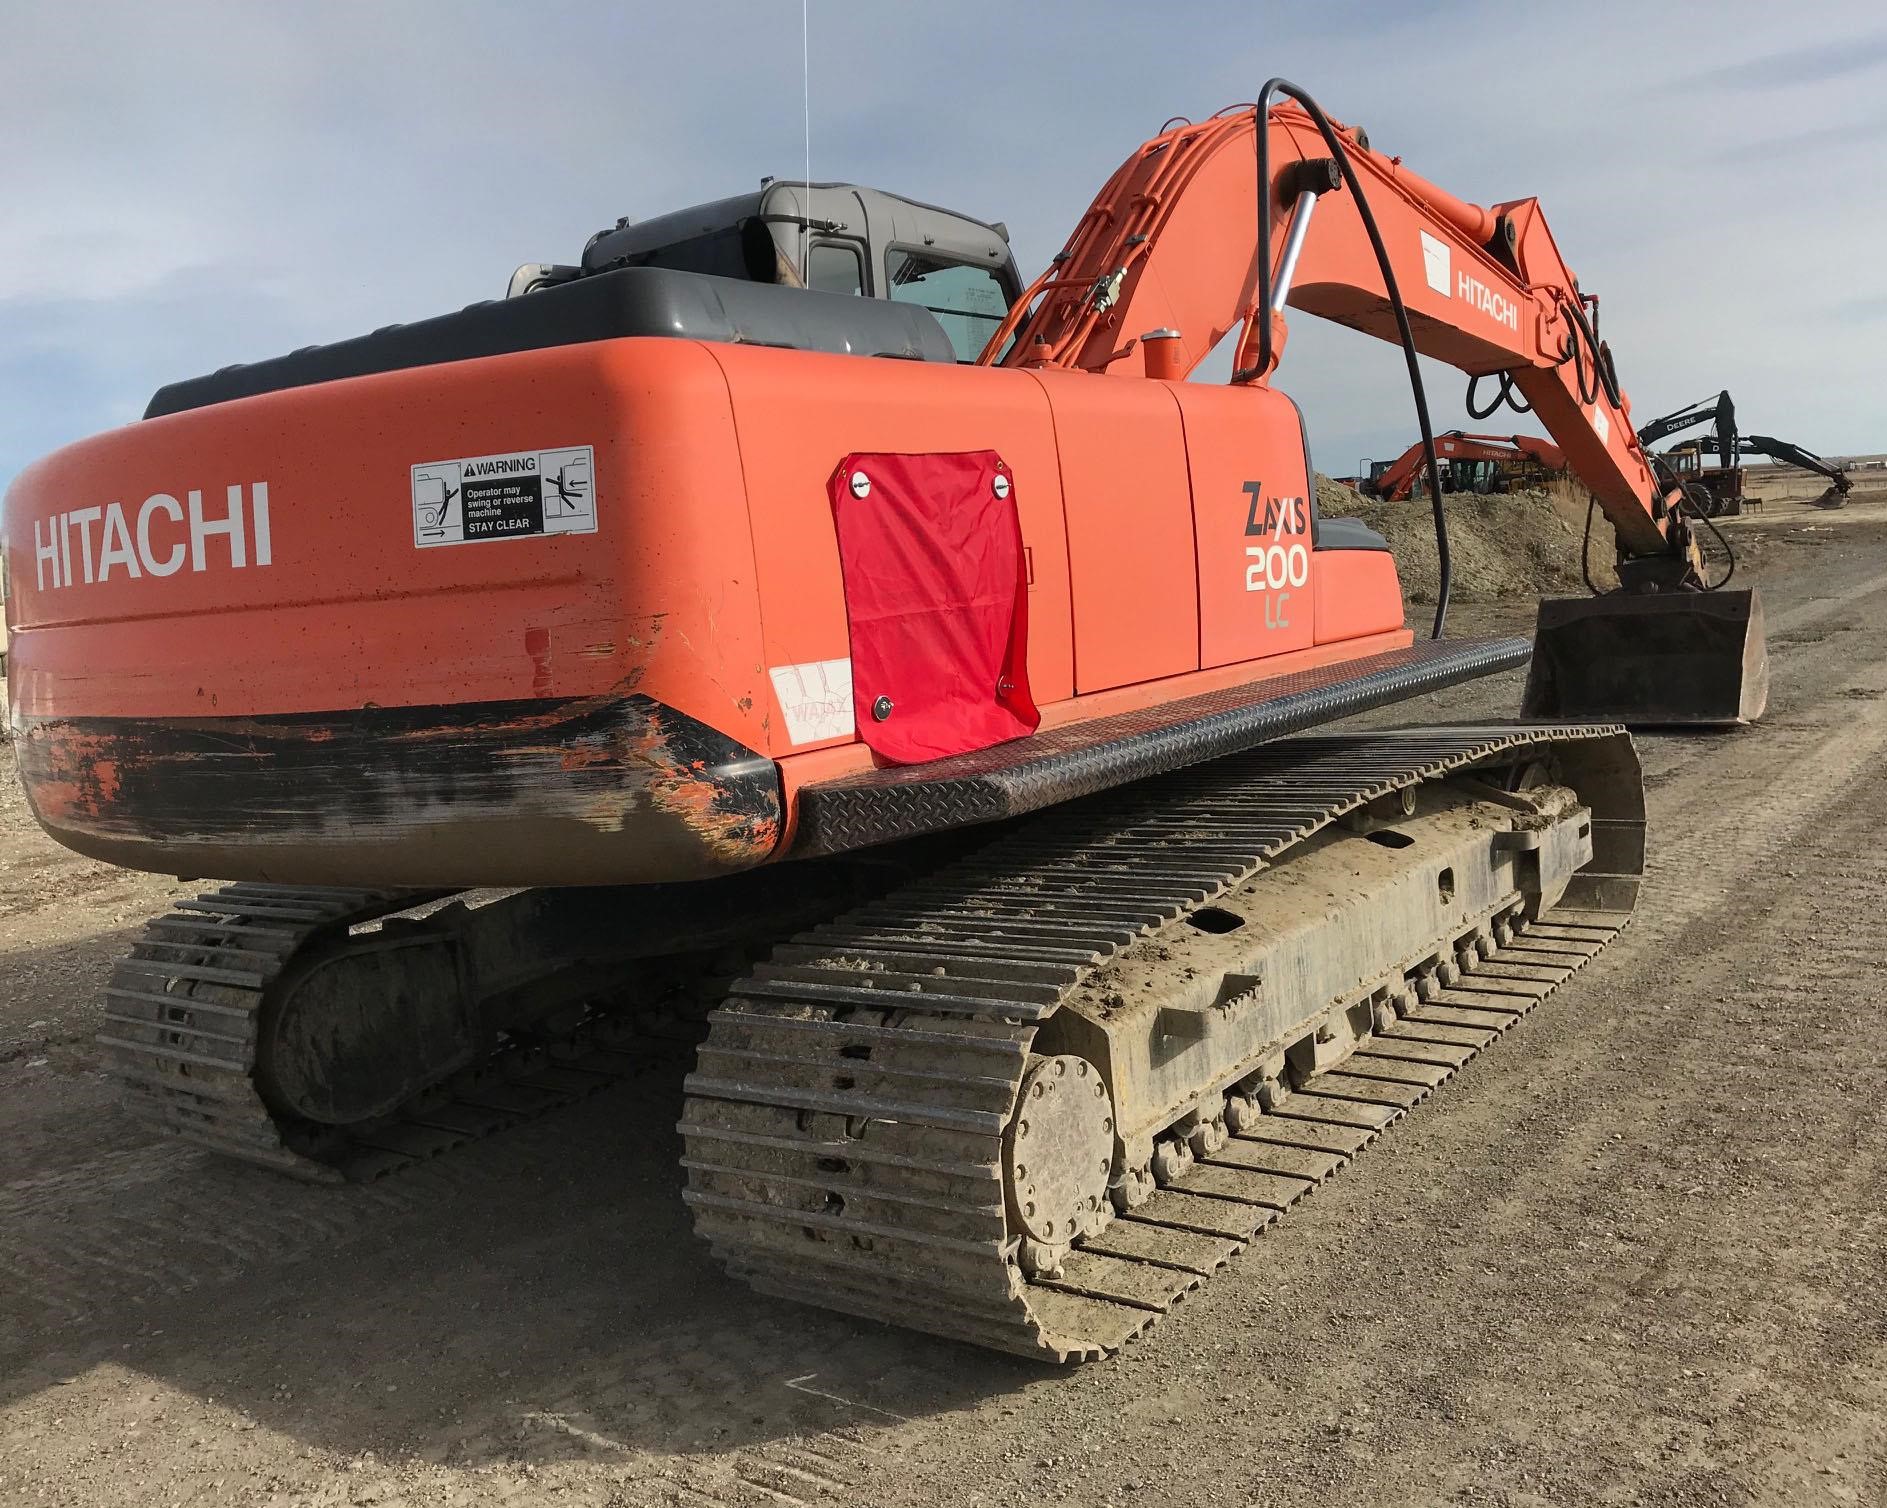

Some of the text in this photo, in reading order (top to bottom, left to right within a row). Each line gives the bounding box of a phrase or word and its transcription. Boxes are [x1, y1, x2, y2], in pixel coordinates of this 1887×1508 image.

[1458, 271, 1518, 331] HITACHI
[1666, 416, 1697, 431] DEERE
[1482, 450, 1512, 459] HITACHI
[476, 457, 536, 476] WARNING
[467, 486, 521, 498] Operator may
[467, 495, 534, 509] swing or reverse
[468, 508, 502, 518] machine
[1242, 481, 1306, 542] ZAXIS
[468, 518, 530, 533] STAY CLEAR
[34, 481, 272, 592] HITACHI
[1245, 543, 1309, 592] 200
[1265, 592, 1290, 630] LC
